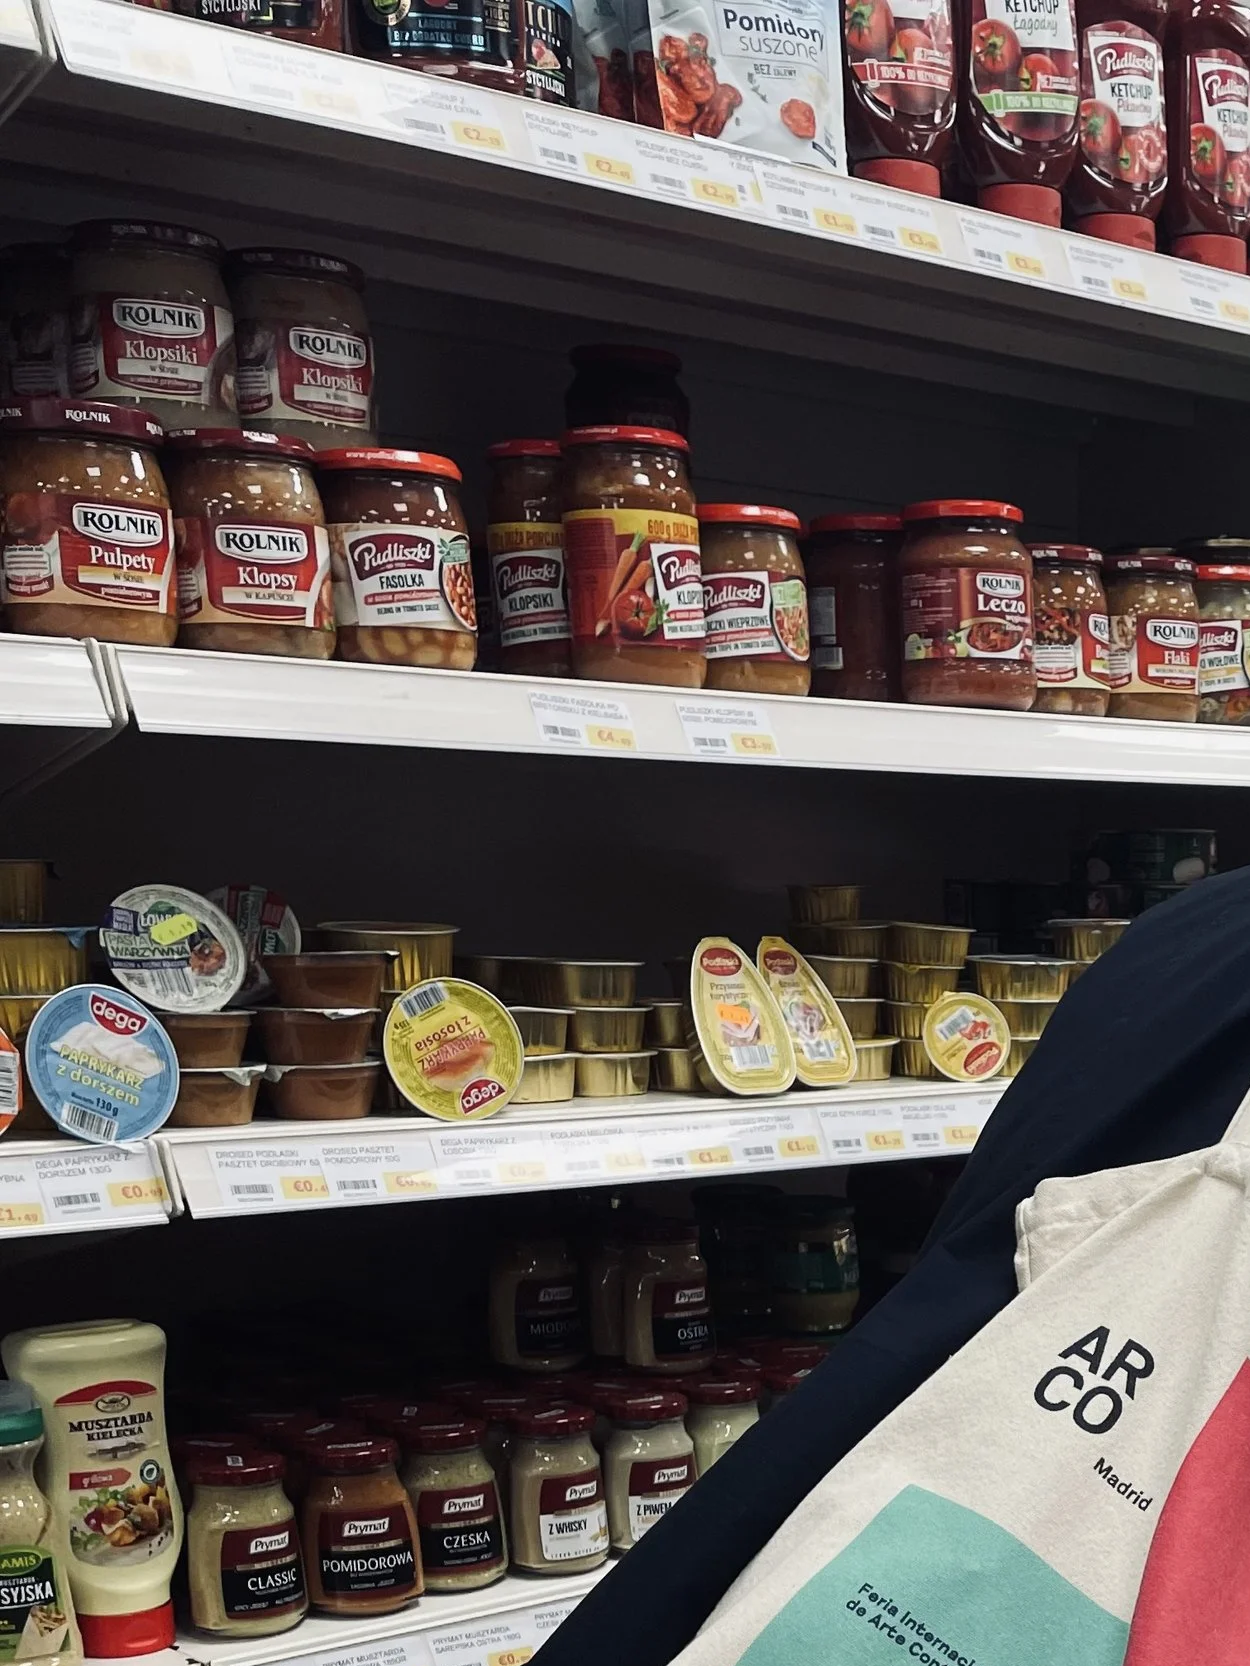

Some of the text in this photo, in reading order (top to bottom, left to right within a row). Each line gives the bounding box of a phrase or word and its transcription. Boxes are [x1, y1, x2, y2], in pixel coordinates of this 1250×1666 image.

[724, 9, 825, 52] Pomidory
[739, 35, 818, 62] suszone
[753, 63, 771, 76] BEZ
[1097, 48, 1157, 75] Pudliszki
[1110, 85, 1153, 101] KETCHUP
[121, 305, 199, 330] ROLNIK
[124, 340, 198, 364] Klopsiki
[299, 335, 363, 360] ROLNIK
[302, 368, 364, 392] Klopsiki
[65, 409, 111, 424] ROLNIK
[83, 512, 158, 536] ROLNIK
[647, 519, 664, 535] 600
[225, 532, 301, 552] ROLNIK
[89, 546, 156, 574] Pulpety
[354, 541, 432, 571] Pudliszki
[238, 567, 298, 591] Klopsy
[379, 574, 425, 590] FASOLKA
[499, 564, 558, 586] Pudliszki
[981, 576, 1022, 591] ROLNIK
[705, 582, 762, 602] Pudliszki
[508, 596, 554, 612] KLOPSIKI
[978, 594, 1026, 613] Leczo
[729, 616, 770, 628] WIEPRZOWE
[1152, 624, 1197, 641] ROLNIK
[1164, 650, 1190, 665] Flaki
[109, 933, 148, 948] PASTA
[110, 944, 191, 959] WARZYWNA
[91, 999, 142, 1032] dega
[59, 1044, 145, 1090] PAPRYKARZ
[69, 1066, 141, 1106] dorszem
[462, 1080, 500, 1109] dega
[363, 1145, 395, 1155] PASZTET
[35, 1154, 120, 1170] DEGA PAPRYKARZ
[218, 1158, 307, 1169] PASZTET DROBIOWY
[39, 1166, 86, 1180] DORSZEM
[677, 1288, 705, 1303] Prymat
[677, 1324, 709, 1340] OSTRA
[1058, 1325, 1155, 1400] AR
[1033, 1366, 1123, 1434] CO
[69, 1411, 154, 1434] MUSZTARDA
[87, 1426, 144, 1441] KIELECKA
[656, 1467, 688, 1482] Prymat
[1093, 1457, 1153, 1511] Madrid
[568, 1483, 597, 1500] Prymat
[446, 1496, 483, 1512] Prymat
[636, 1502, 642, 1516] Z
[344, 1520, 388, 1535] Prymat
[548, 1519, 587, 1535] Z WHISKY
[254, 1534, 289, 1552] Prymat
[443, 1530, 491, 1548] CZESKA
[323, 1551, 413, 1573] POMIDOROWA
[247, 1568, 297, 1592] CLASSIC
[0, 1581, 54, 1605] SYJSKA
[857, 1582, 899, 1616] Feria
[845, 1598, 867, 1617] de
[867, 1613, 906, 1645] Arte
[432, 1625, 510, 1646] PRYMAT MUSZTARDA
[358, 1646, 405, 1664] MUSZTARDA
